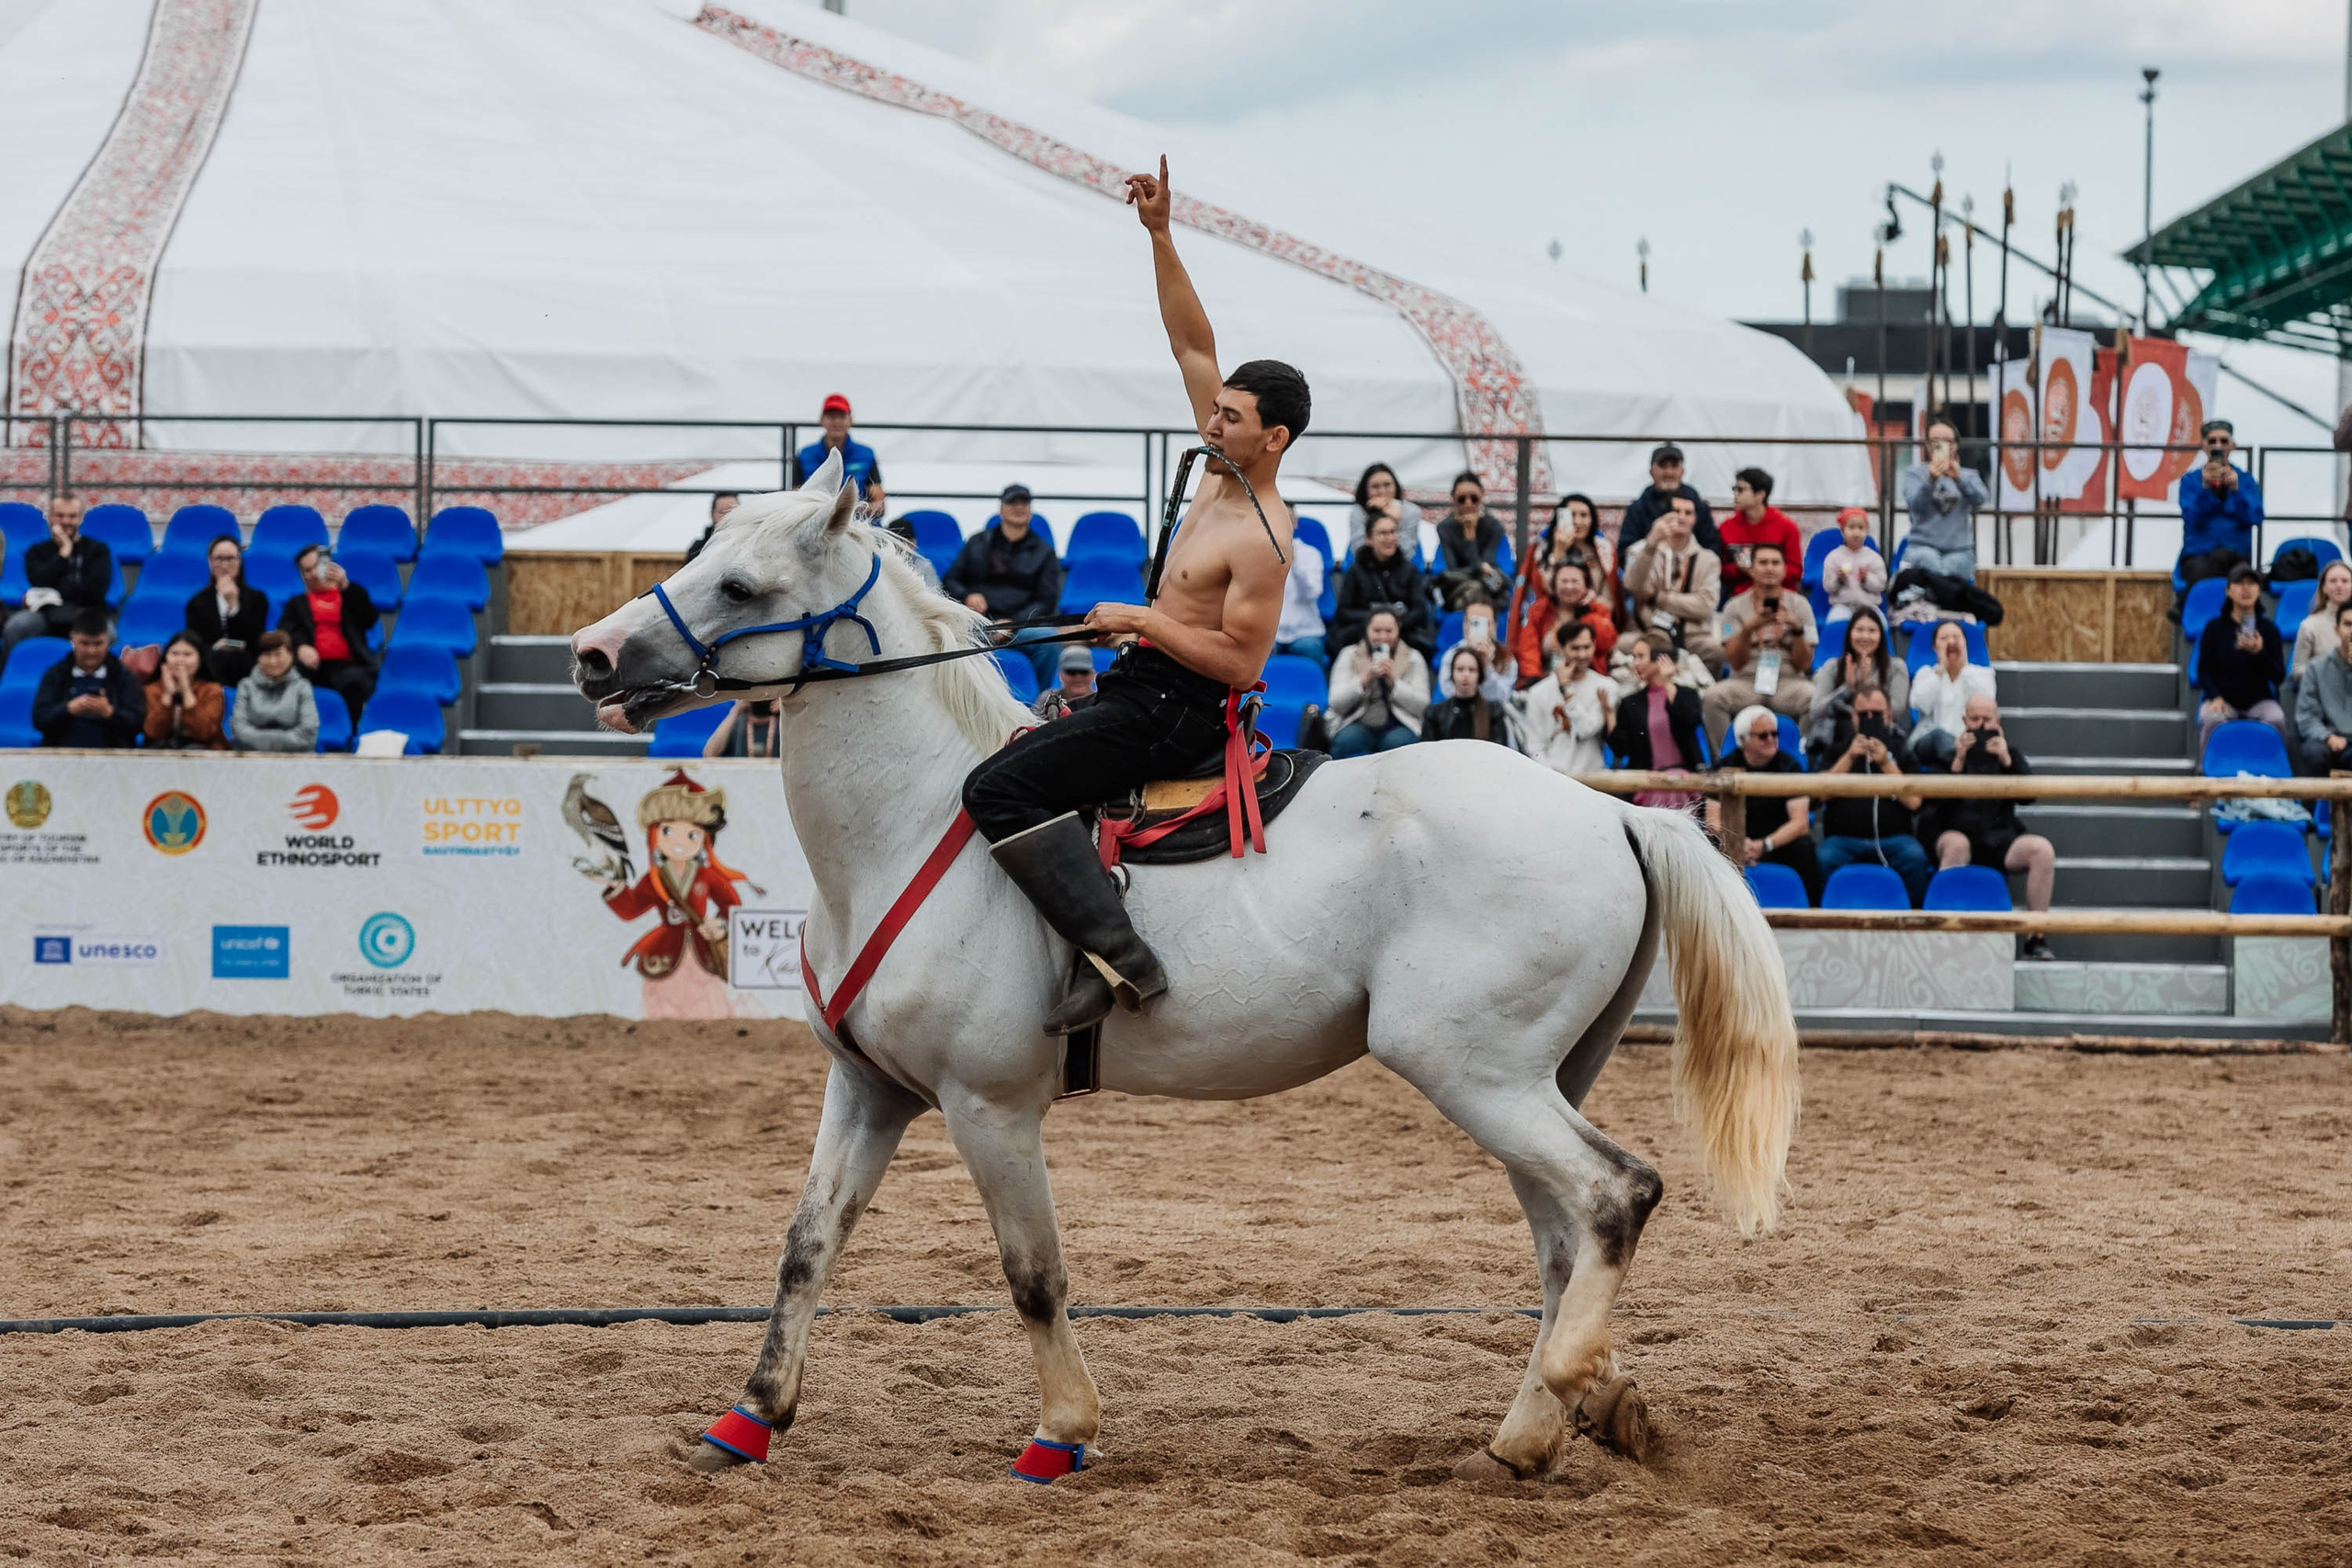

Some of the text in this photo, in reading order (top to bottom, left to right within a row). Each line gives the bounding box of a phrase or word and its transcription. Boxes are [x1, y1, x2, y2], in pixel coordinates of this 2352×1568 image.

[424, 798, 521, 815] ULTTYQ
[424, 822, 521, 840] SPORT
[286, 837, 355, 849] WORLD
[256, 852, 381, 865] ETHNOSPORT
[79, 944, 157, 958] unesco
[743, 943, 760, 956] to
